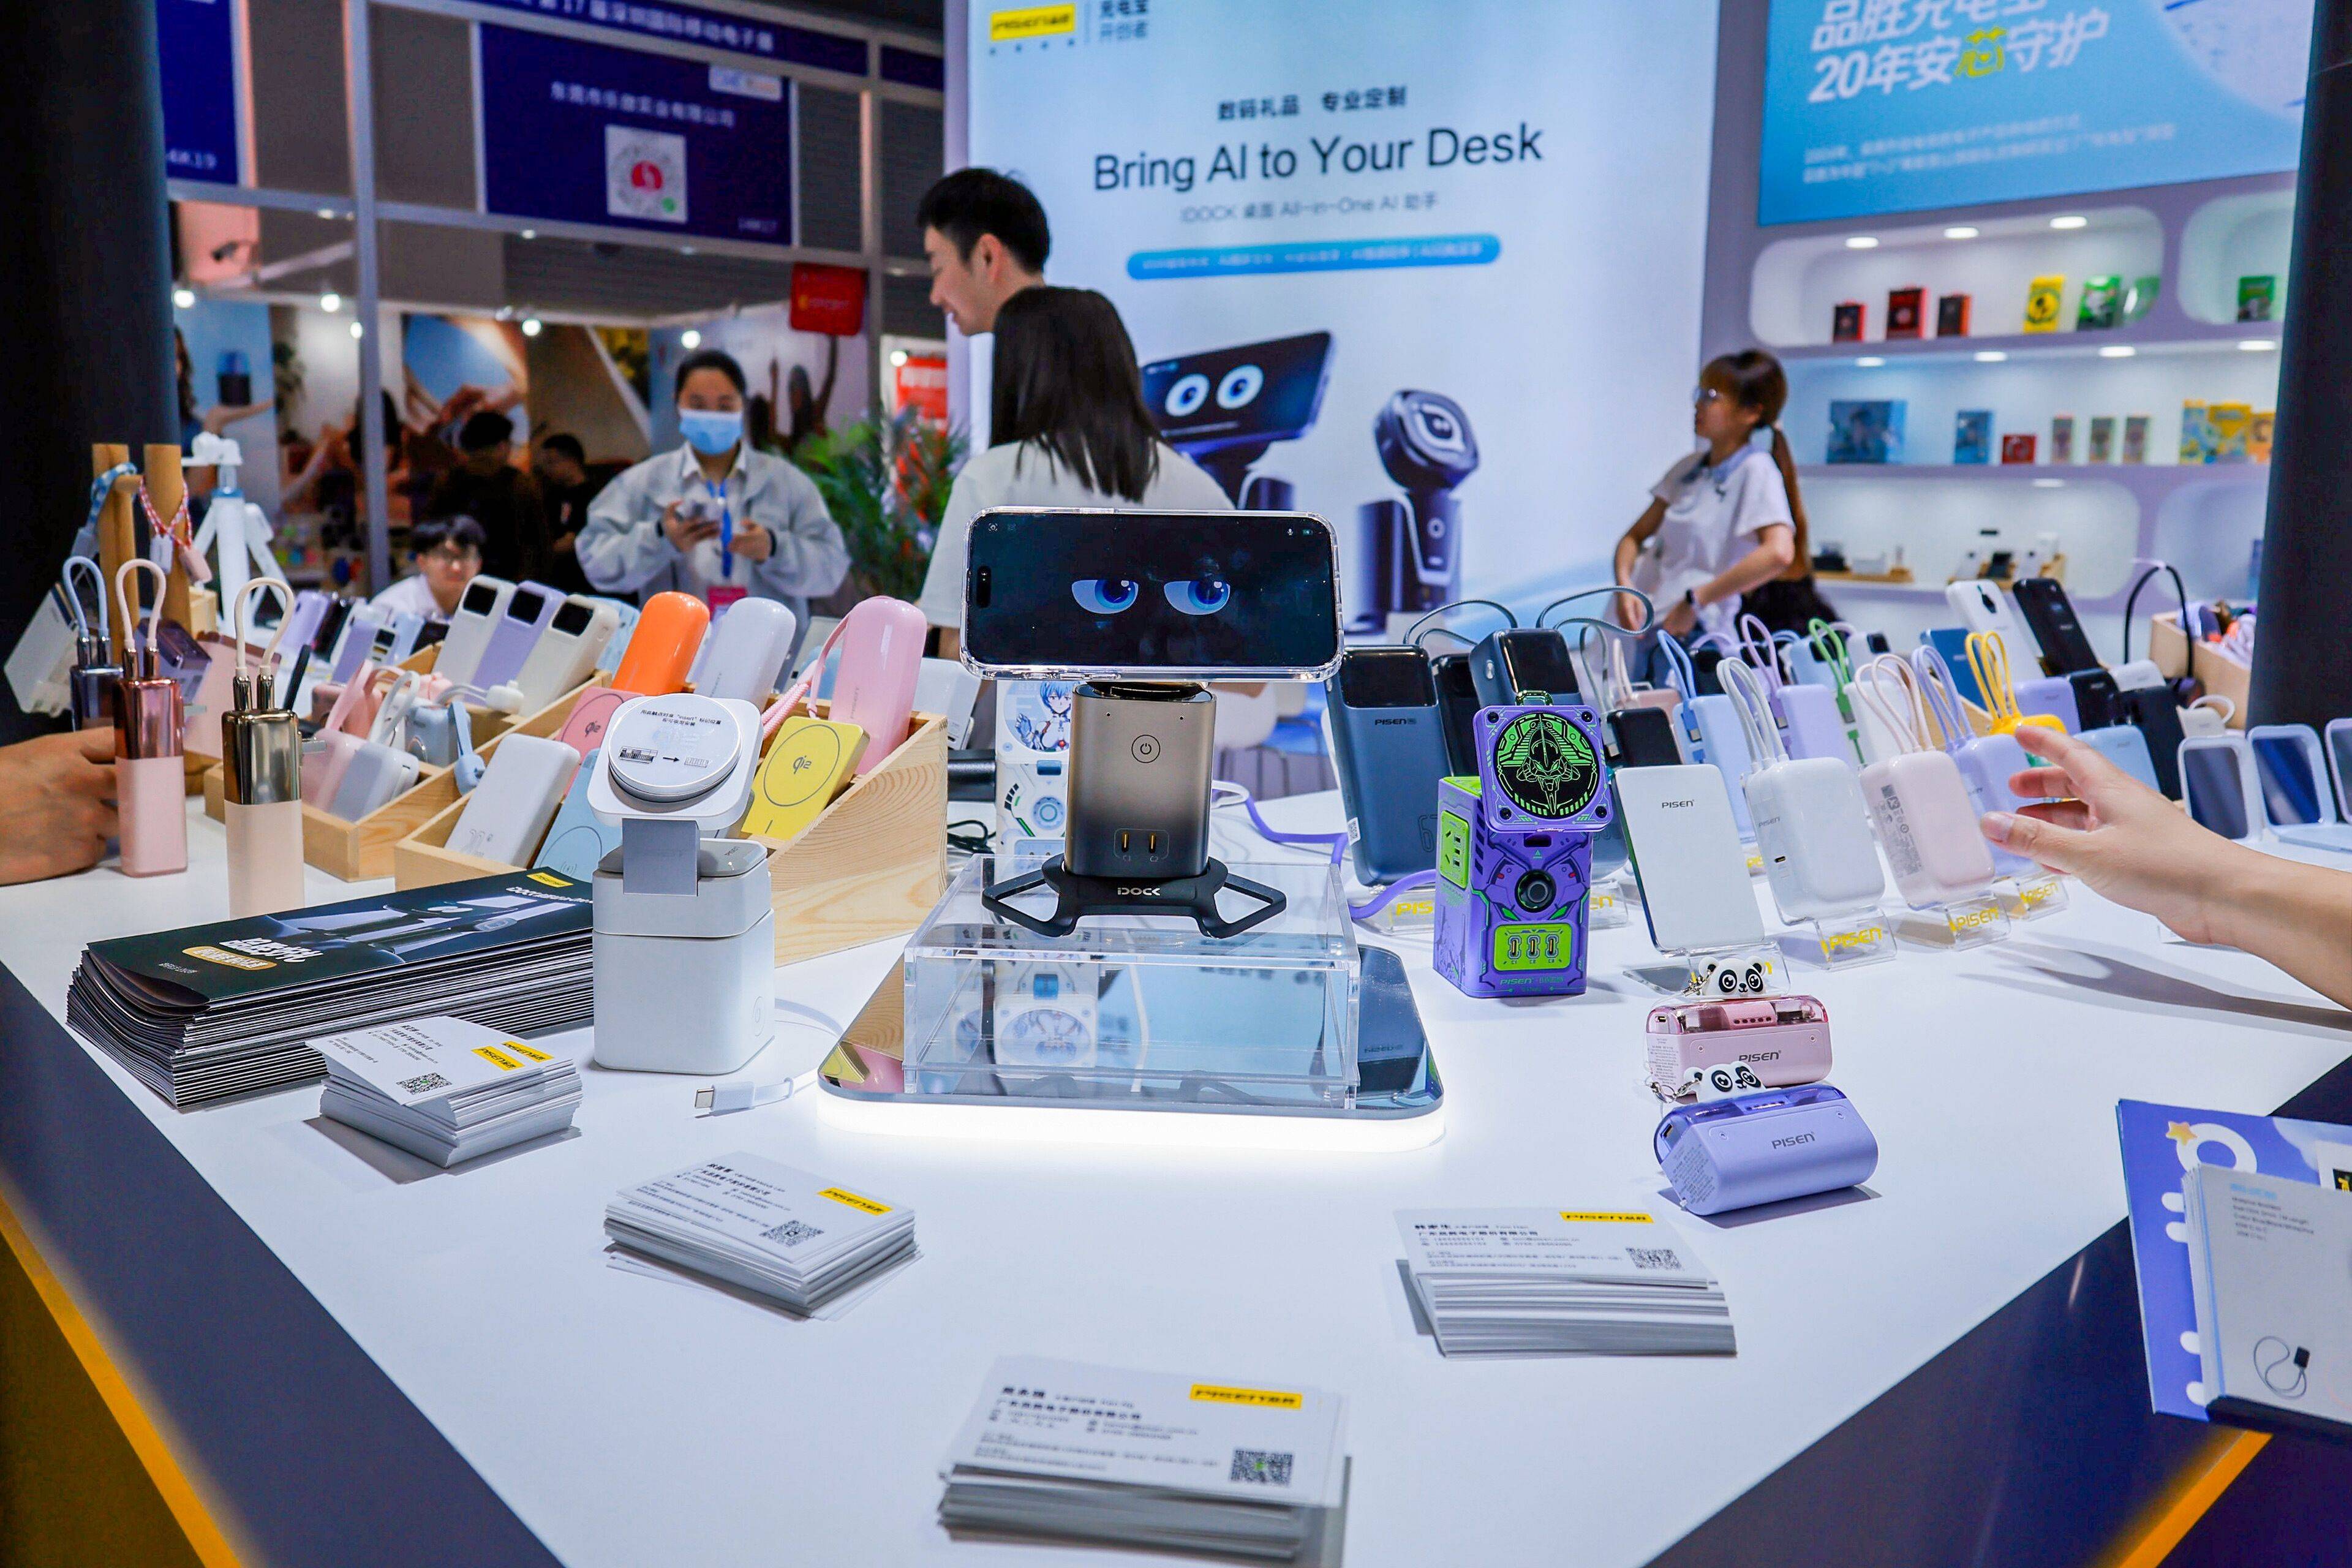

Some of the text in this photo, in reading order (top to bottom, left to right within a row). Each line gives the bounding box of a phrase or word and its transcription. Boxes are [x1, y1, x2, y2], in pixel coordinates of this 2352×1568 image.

[1807, 9, 2111, 102] 20年安芯守护
[1095, 121, 1543, 192] Bring AI to Your Desk
[1661, 800, 1694, 809] PISEN
[1758, 816, 1781, 827] PISEN
[1117, 888, 1161, 896] iDOCK
[1396, 900, 1433, 916] PIS
[1955, 907, 2000, 930] PISEN
[1828, 927, 1883, 950] PISEN
[1738, 1051, 1781, 1063] PISEN
[1771, 1133, 1815, 1150] PISEN
